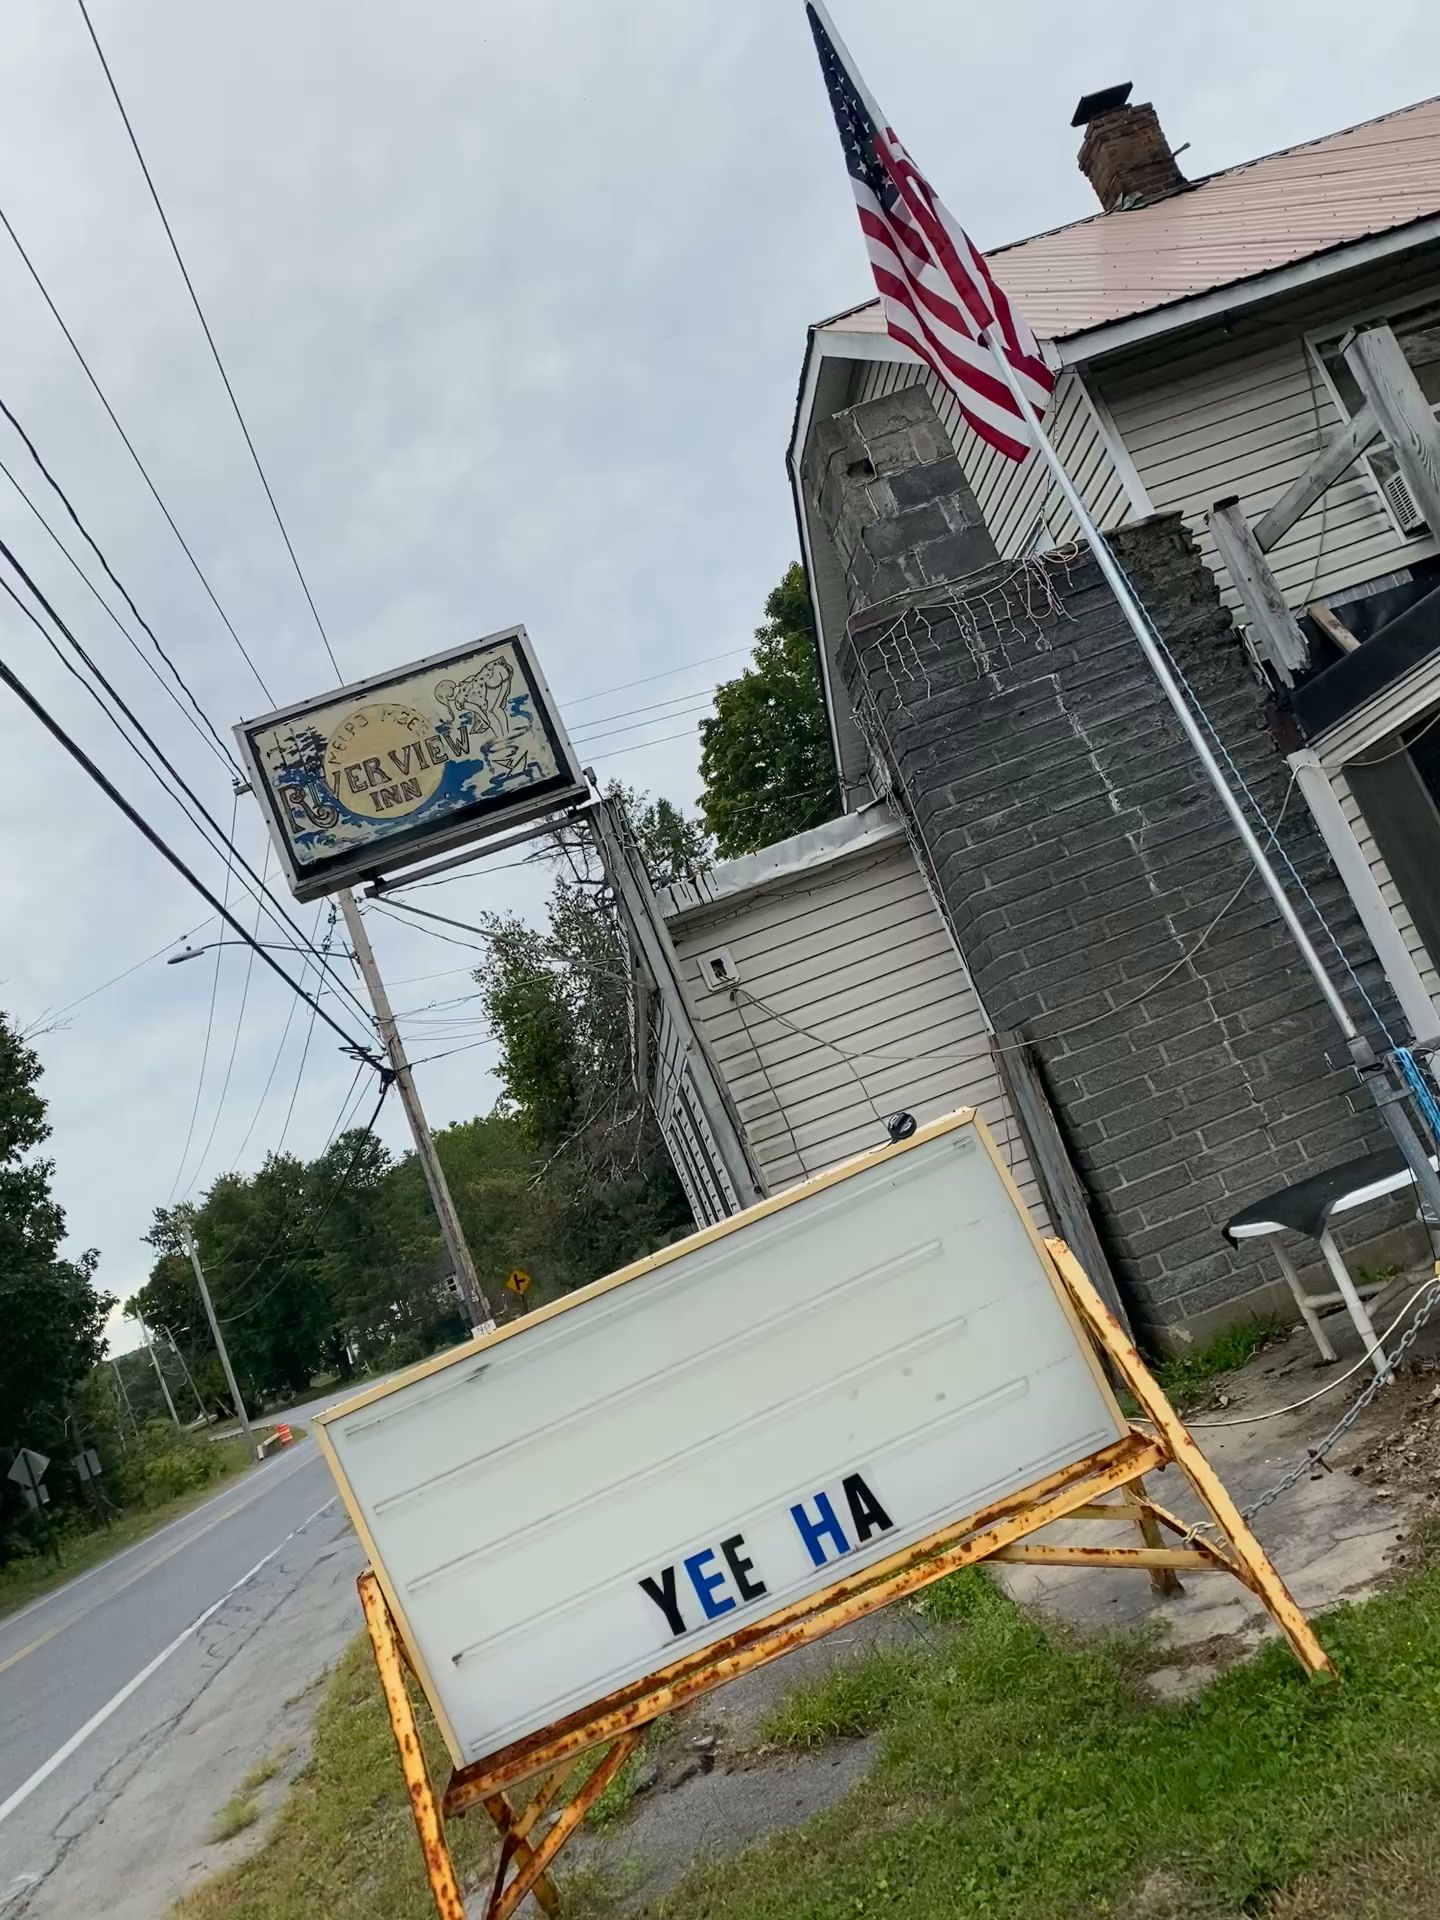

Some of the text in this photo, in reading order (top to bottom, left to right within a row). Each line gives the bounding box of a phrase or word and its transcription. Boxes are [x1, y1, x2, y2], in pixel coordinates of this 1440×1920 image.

[369, 777, 422, 812] INN
[638, 1472, 894, 1636] YEE HA
